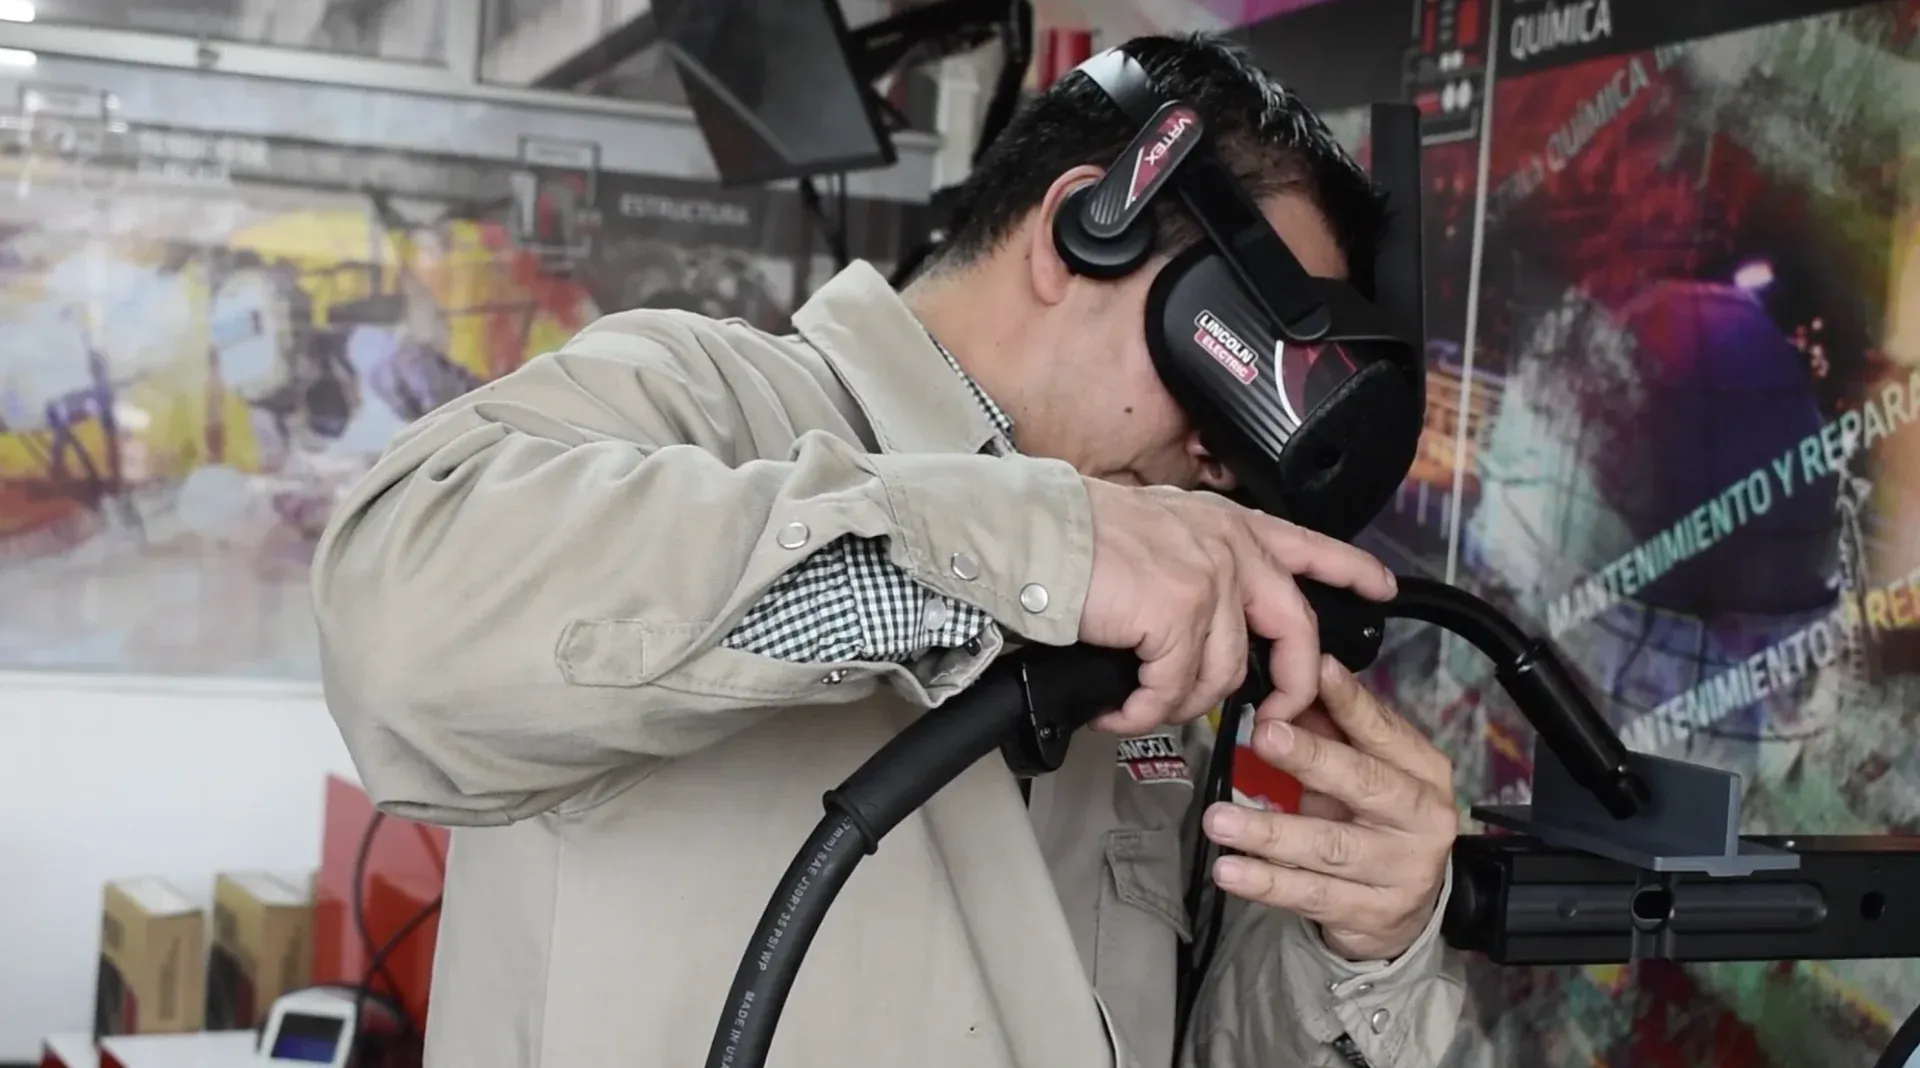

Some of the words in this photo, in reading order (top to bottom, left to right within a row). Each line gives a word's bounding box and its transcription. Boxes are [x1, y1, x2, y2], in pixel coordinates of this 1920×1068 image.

[1144, 116, 1192, 167] VRTEX
[1200, 314, 1254, 364] LINCOLN
[1202, 335, 1250, 379] ELECTRIC
[1547, 468, 1772, 638] MANTENIMIENTO
[1773, 449, 1794, 498] Y
[1619, 620, 1834, 750] ANTENIMIENTO
[807, 852, 827, 876] SAE
[787, 876, 810, 911] J30R7
[777, 912, 791, 928] 35
[766, 928, 783, 950] PSI
[758, 951, 773, 971] WP
[734, 990, 755, 1028] MADE
[729, 1028, 741, 1044] IN
[720, 1045, 736, 1068] USA
